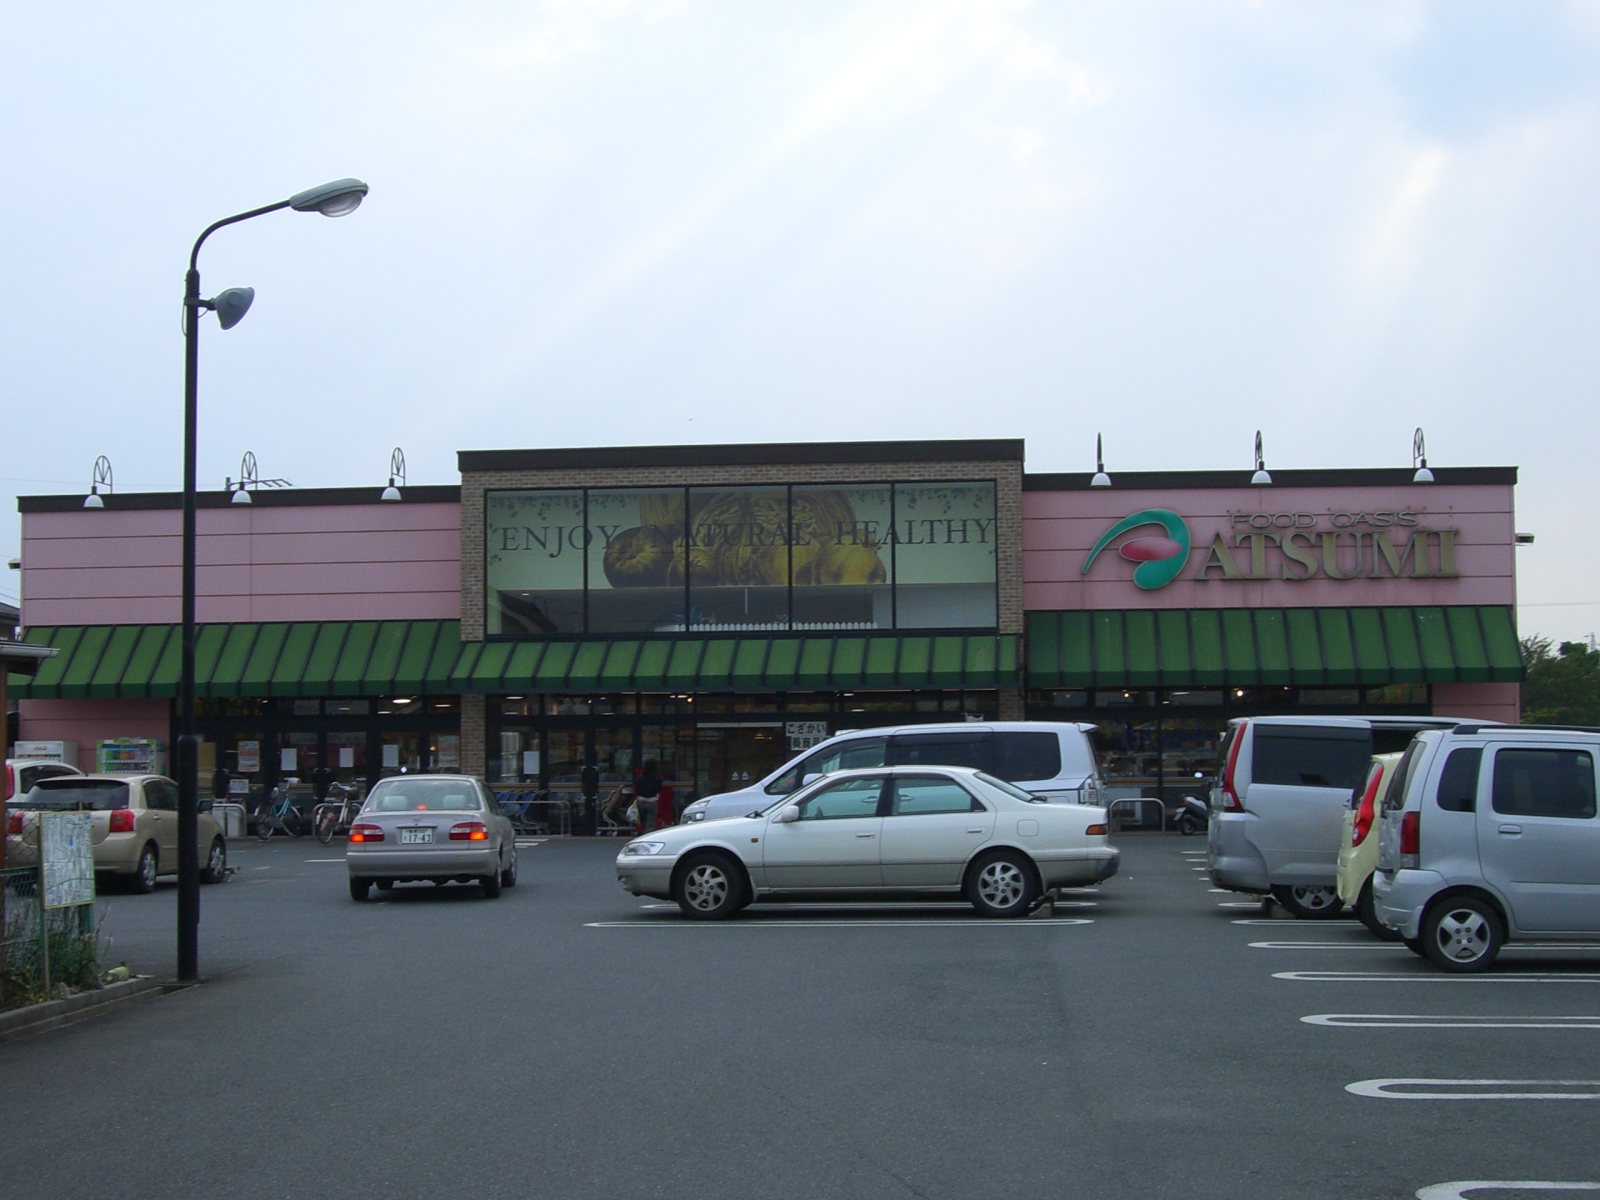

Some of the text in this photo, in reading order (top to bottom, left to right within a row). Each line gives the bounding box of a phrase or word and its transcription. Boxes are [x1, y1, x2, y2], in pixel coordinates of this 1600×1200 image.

[1230, 512, 1318, 529] FOOD
[499, 518, 995, 558] ENJOY NATURAL HEALTHY
[1194, 527, 1461, 580] ATSUMI
[787, 723, 826, 734] こざかい
[408, 834, 430, 842] 17-43
